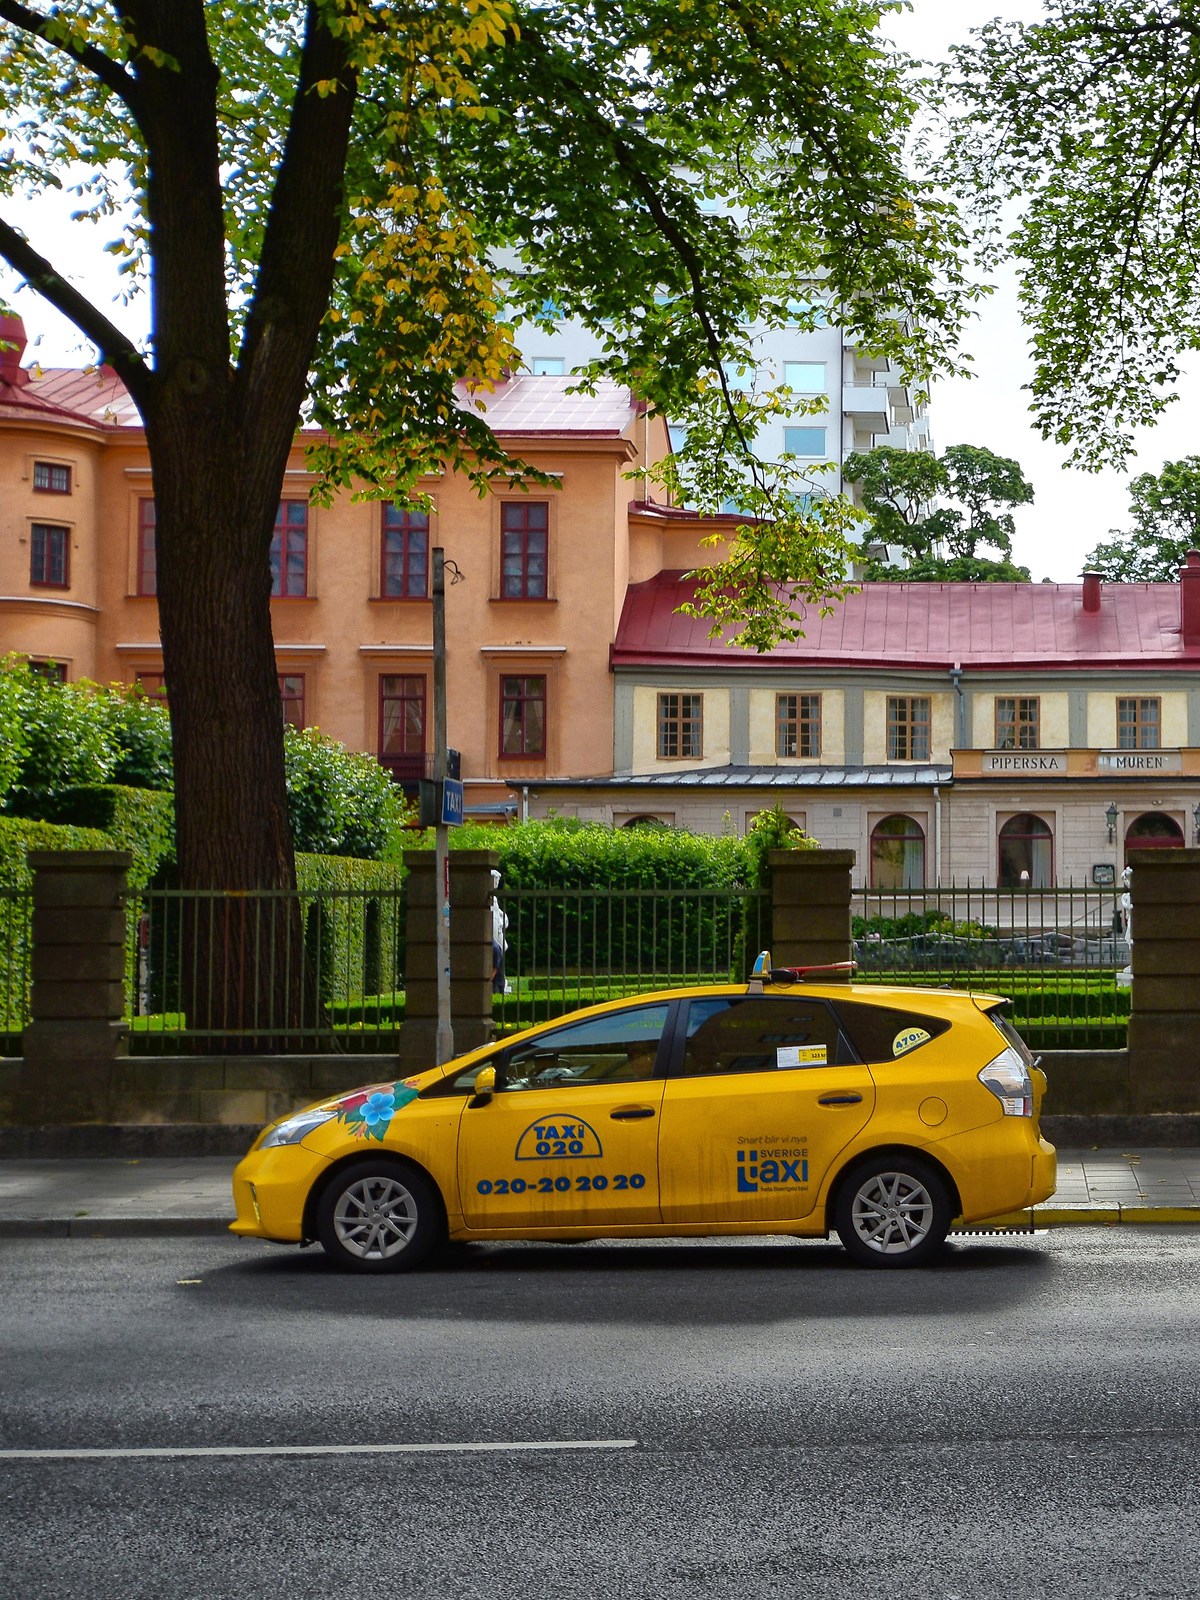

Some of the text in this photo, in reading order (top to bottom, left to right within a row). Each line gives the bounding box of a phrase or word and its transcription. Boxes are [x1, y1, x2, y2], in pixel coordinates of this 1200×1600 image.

[991, 756, 1163, 770] PIPERSKA MUREN
[446, 791, 461, 812] TAXI
[737, 1136, 762, 1145] Snart
[790, 1136, 808, 1145] nya
[535, 1140, 583, 1156] 020
[760, 1149, 808, 1158] SVERIGE
